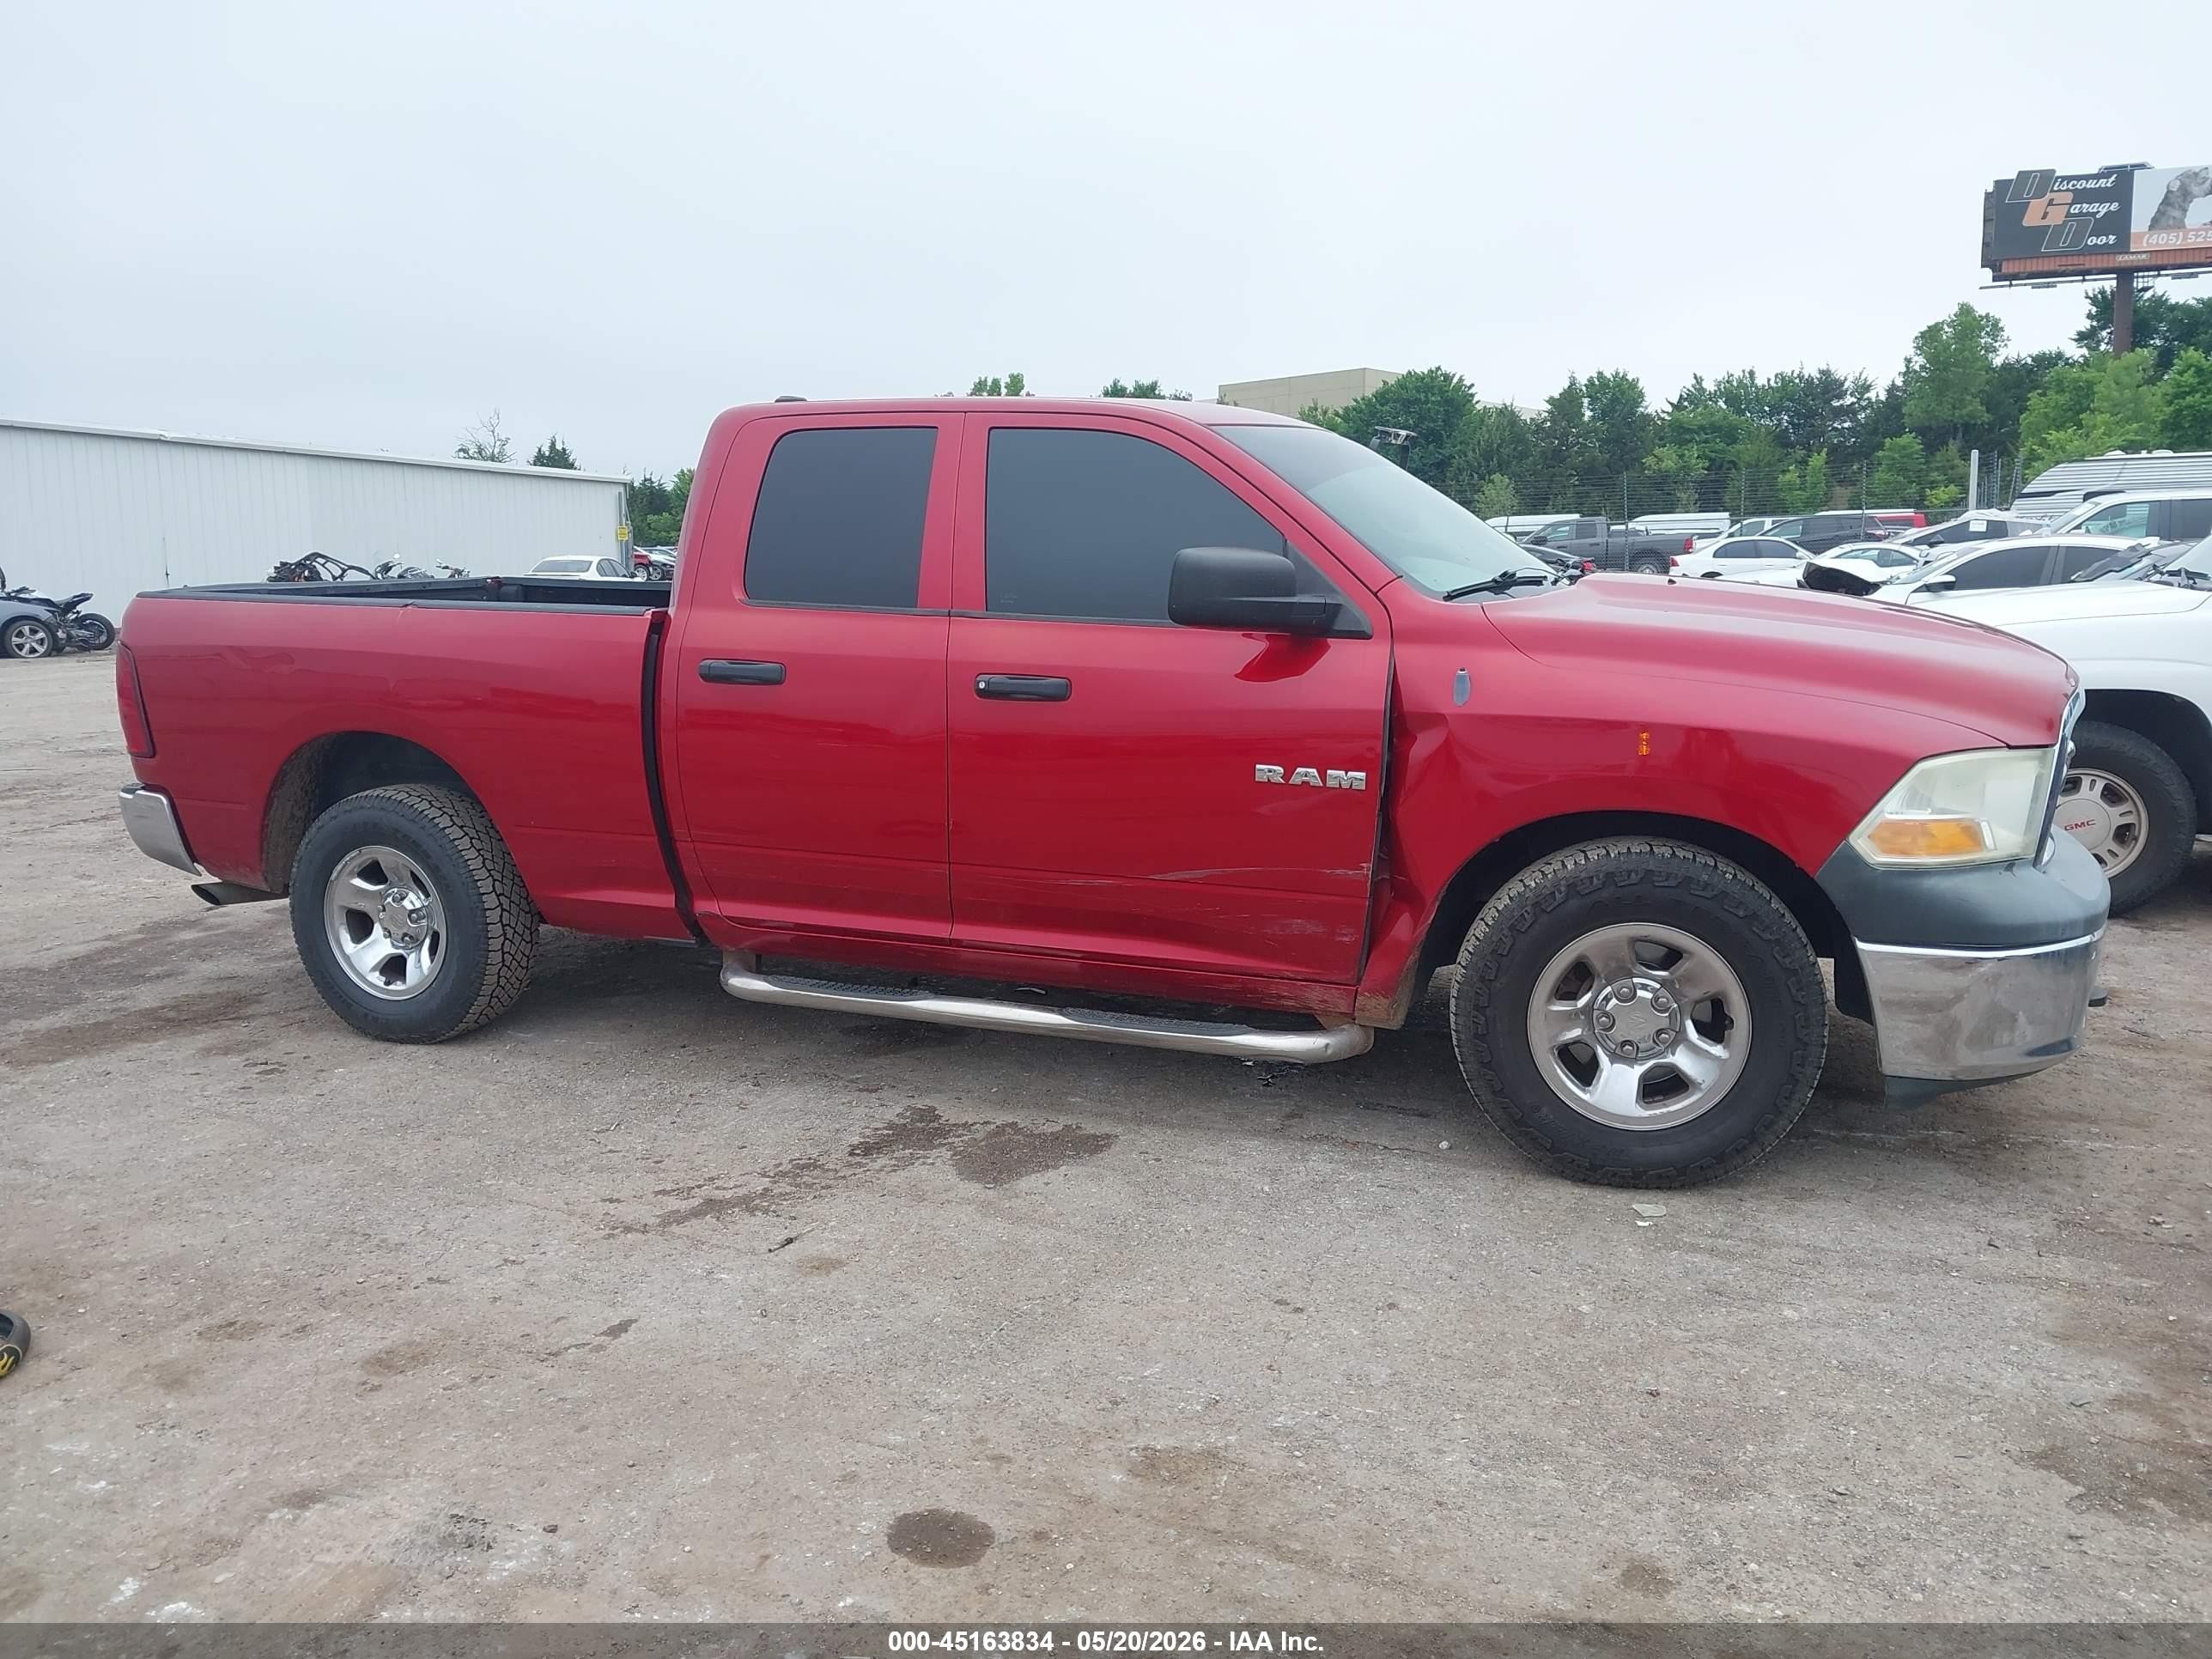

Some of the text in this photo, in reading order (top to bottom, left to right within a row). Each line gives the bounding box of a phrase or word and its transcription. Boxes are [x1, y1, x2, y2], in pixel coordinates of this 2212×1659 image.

[2006, 168, 2118, 203] Discount
[2022, 191, 2121, 227] Garage
[2041, 216, 2118, 252] Door
[2142, 232, 2184, 247] (405)
[1255, 763, 1367, 791] RAM
[2064, 818, 2096, 831] GMC
